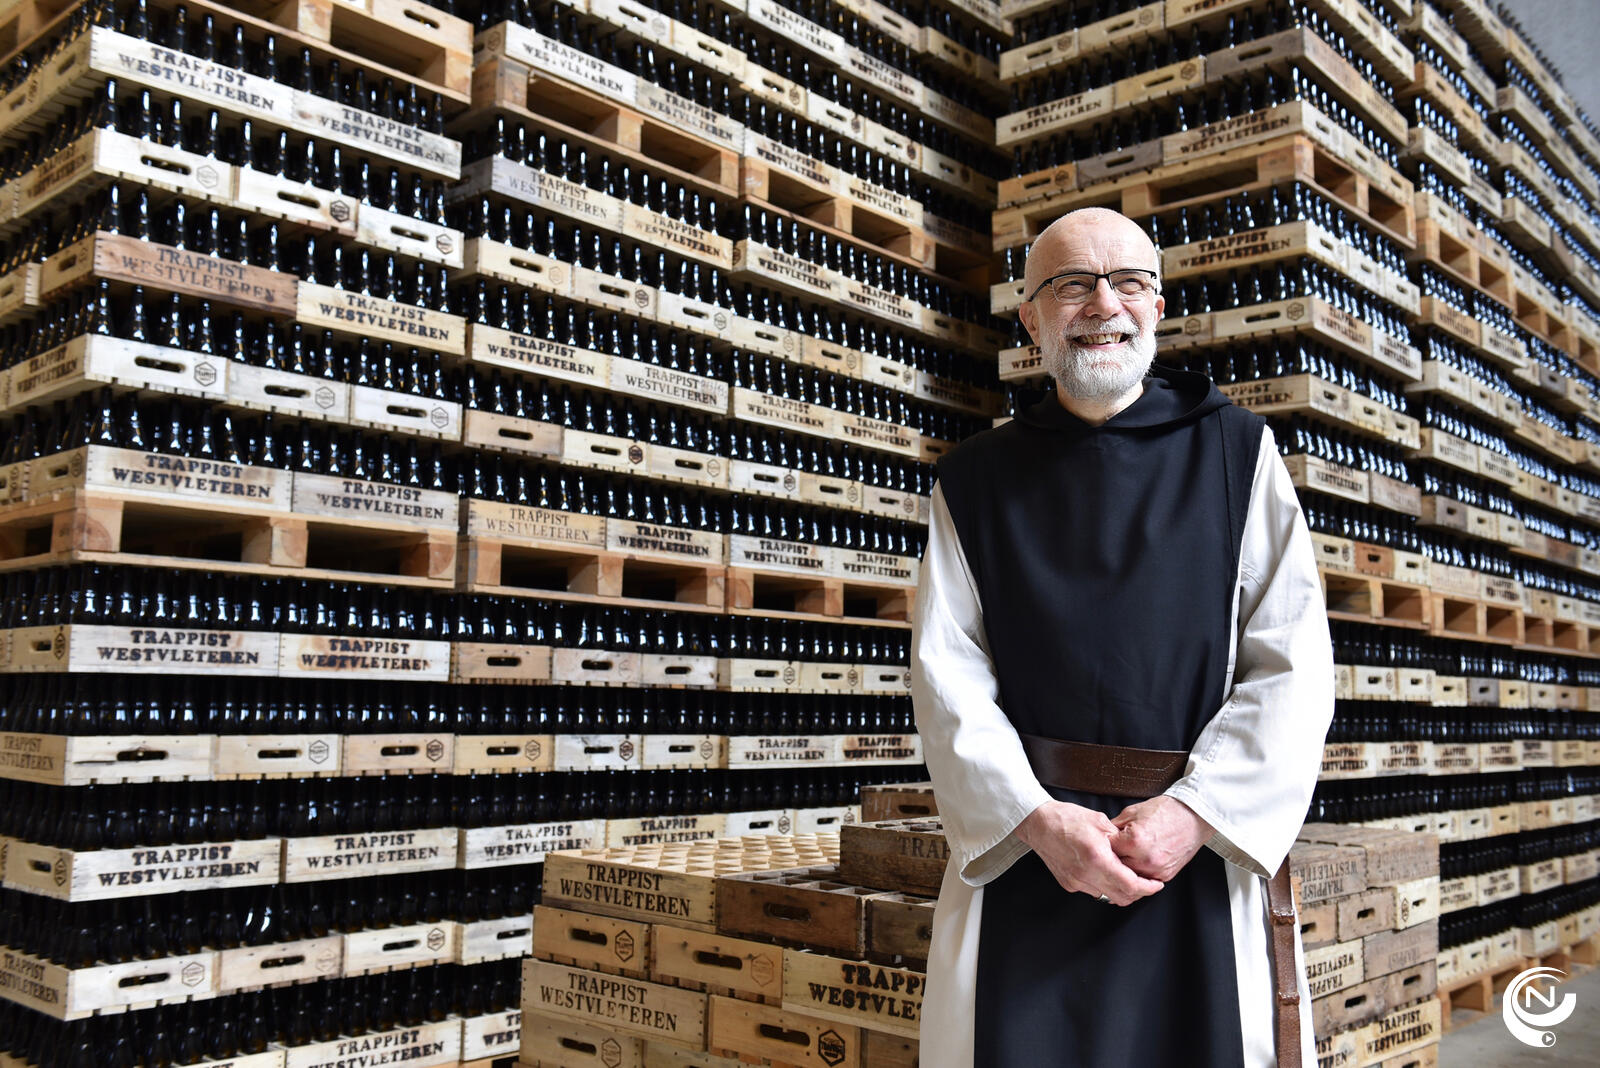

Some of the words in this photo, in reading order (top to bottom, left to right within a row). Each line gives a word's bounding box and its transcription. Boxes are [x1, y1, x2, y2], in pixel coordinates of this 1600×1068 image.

[543, 39, 605, 72] TRAPPIST
[664, 92, 718, 124] TRAPPIST
[1027, 95, 1083, 119] TRAPPIST
[342, 108, 423, 142] TRAPPIST
[1181, 116, 1289, 154] WESTVLETEREN
[1201, 111, 1267, 138] TRAPPIST
[319, 116, 445, 164] WESTVLETEREN
[531, 171, 588, 199] TRAPPIST
[509, 176, 608, 219] WESTVLETEREN
[634, 220, 720, 257] WESTVLETEREN
[652, 215, 705, 239] TRAPPIST
[1179, 238, 1291, 267] WESTVLETEREN
[1199, 231, 1268, 252] TRAPPIST
[157, 248, 247, 280] TRAPPIST
[759, 258, 831, 291] WESTVLETEREN
[772, 252, 818, 275] TRAPPIST
[122, 255, 275, 302] WESTVLETEREN
[320, 304, 449, 341] WESTVLETEREN
[508, 335, 577, 358] TRAPPIST
[488, 344, 596, 376] WESTVLETEREN
[626, 374, 717, 405] WESTVLETEREN
[645, 367, 699, 390] TRAPPIST
[762, 395, 811, 414] TRAPPIST
[145, 454, 243, 479] TRAPPIST
[112, 467, 271, 498] WESTVLETEREN
[343, 481, 422, 503] TRAPPIST
[317, 493, 445, 520] WESTVLETEREN
[510, 507, 570, 527] TRAPPIST
[486, 518, 590, 542] WESTVLETEREN
[636, 525, 692, 542] TRAPPIST
[618, 535, 709, 556] WESTVLETEREN
[760, 540, 809, 556] TRAPPIST
[744, 551, 824, 569] WESTVLETEREN
[843, 562, 912, 578] WESTVLETEREN
[856, 553, 899, 567] TRAPPIST
[131, 630, 232, 646] TRAPPIST
[329, 638, 410, 655] TRAPPIST
[97, 646, 259, 664] WESTVLETEREN
[301, 654, 430, 671] WESTVLETEREN
[3, 735, 43, 753] TRAPPIST
[758, 738, 810, 750] TRAPPIST
[858, 736, 903, 748] TRAPPIST
[0, 751, 54, 771] STVLETEREN
[506, 824, 573, 841] TRAPPIST
[640, 818, 698, 832] TRAPPIST
[334, 833, 416, 851] TRAPPIST
[484, 837, 592, 858] WESTVLETEREN
[622, 830, 715, 846] WESTVLETEREN
[132, 846, 232, 866] TRAPPIST
[307, 846, 439, 869] WESTVLETEREN
[98, 860, 260, 887] WESTVLETEREN
[586, 864, 663, 891] TRAPPIST
[560, 878, 691, 917] WESTVLETEREN
[2, 953, 47, 982] TRAPPIST
[0, 969, 60, 1004] ESTVLETEREN
[568, 972, 647, 1005] TRAPPIST
[540, 985, 678, 1033] WESTVLETEREN
[1379, 1010, 1421, 1034] TRAPPIST
[337, 1030, 420, 1056] TRAPPIST
[1366, 1023, 1433, 1054] WESTVLETEREN
[308, 1041, 445, 1068] WESTVLETEREN
